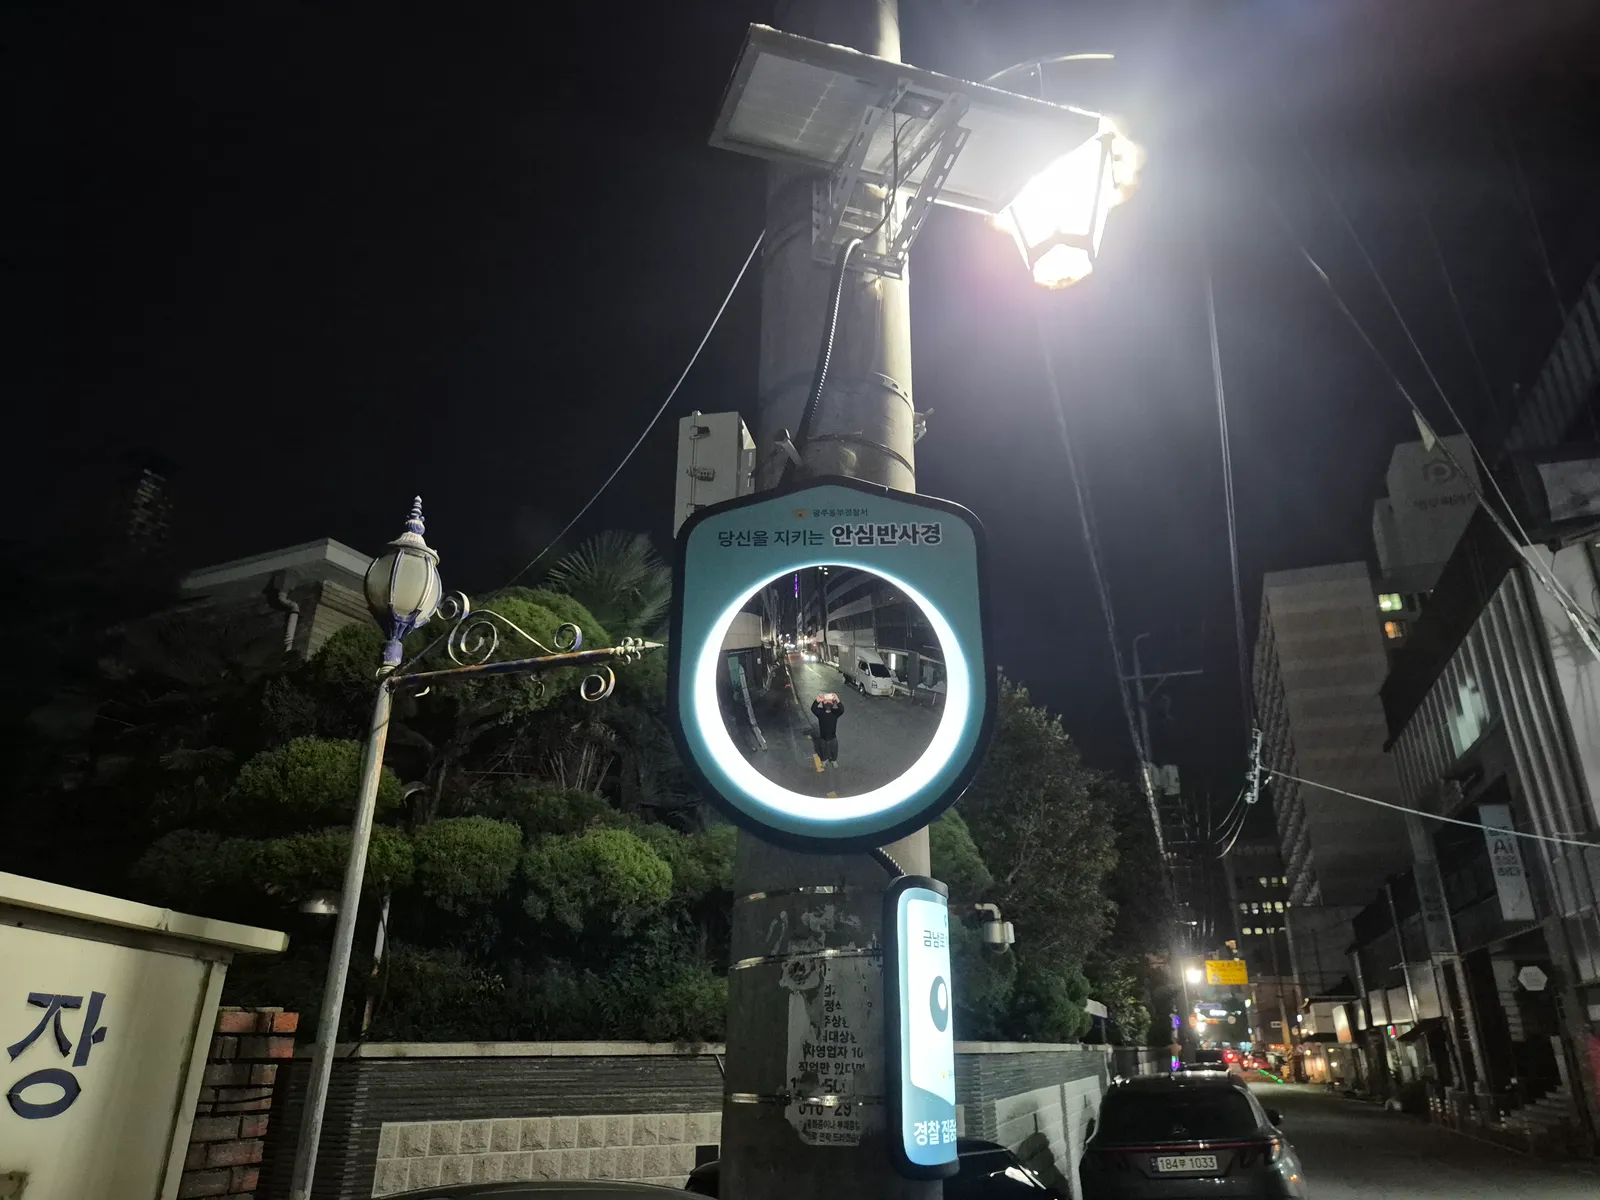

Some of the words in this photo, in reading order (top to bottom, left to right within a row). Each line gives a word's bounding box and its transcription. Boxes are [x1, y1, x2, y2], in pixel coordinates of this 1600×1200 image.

[813, 508, 868, 518] 광주동부경찰서
[718, 529, 769, 547] 당신을
[774, 529, 824, 546] 지키는
[831, 523, 942, 546] 안심반사경
[6, 990, 108, 1120] 장
[913, 1119, 940, 1146] 경찰
[1189, 1157, 1216, 1168] 1033
